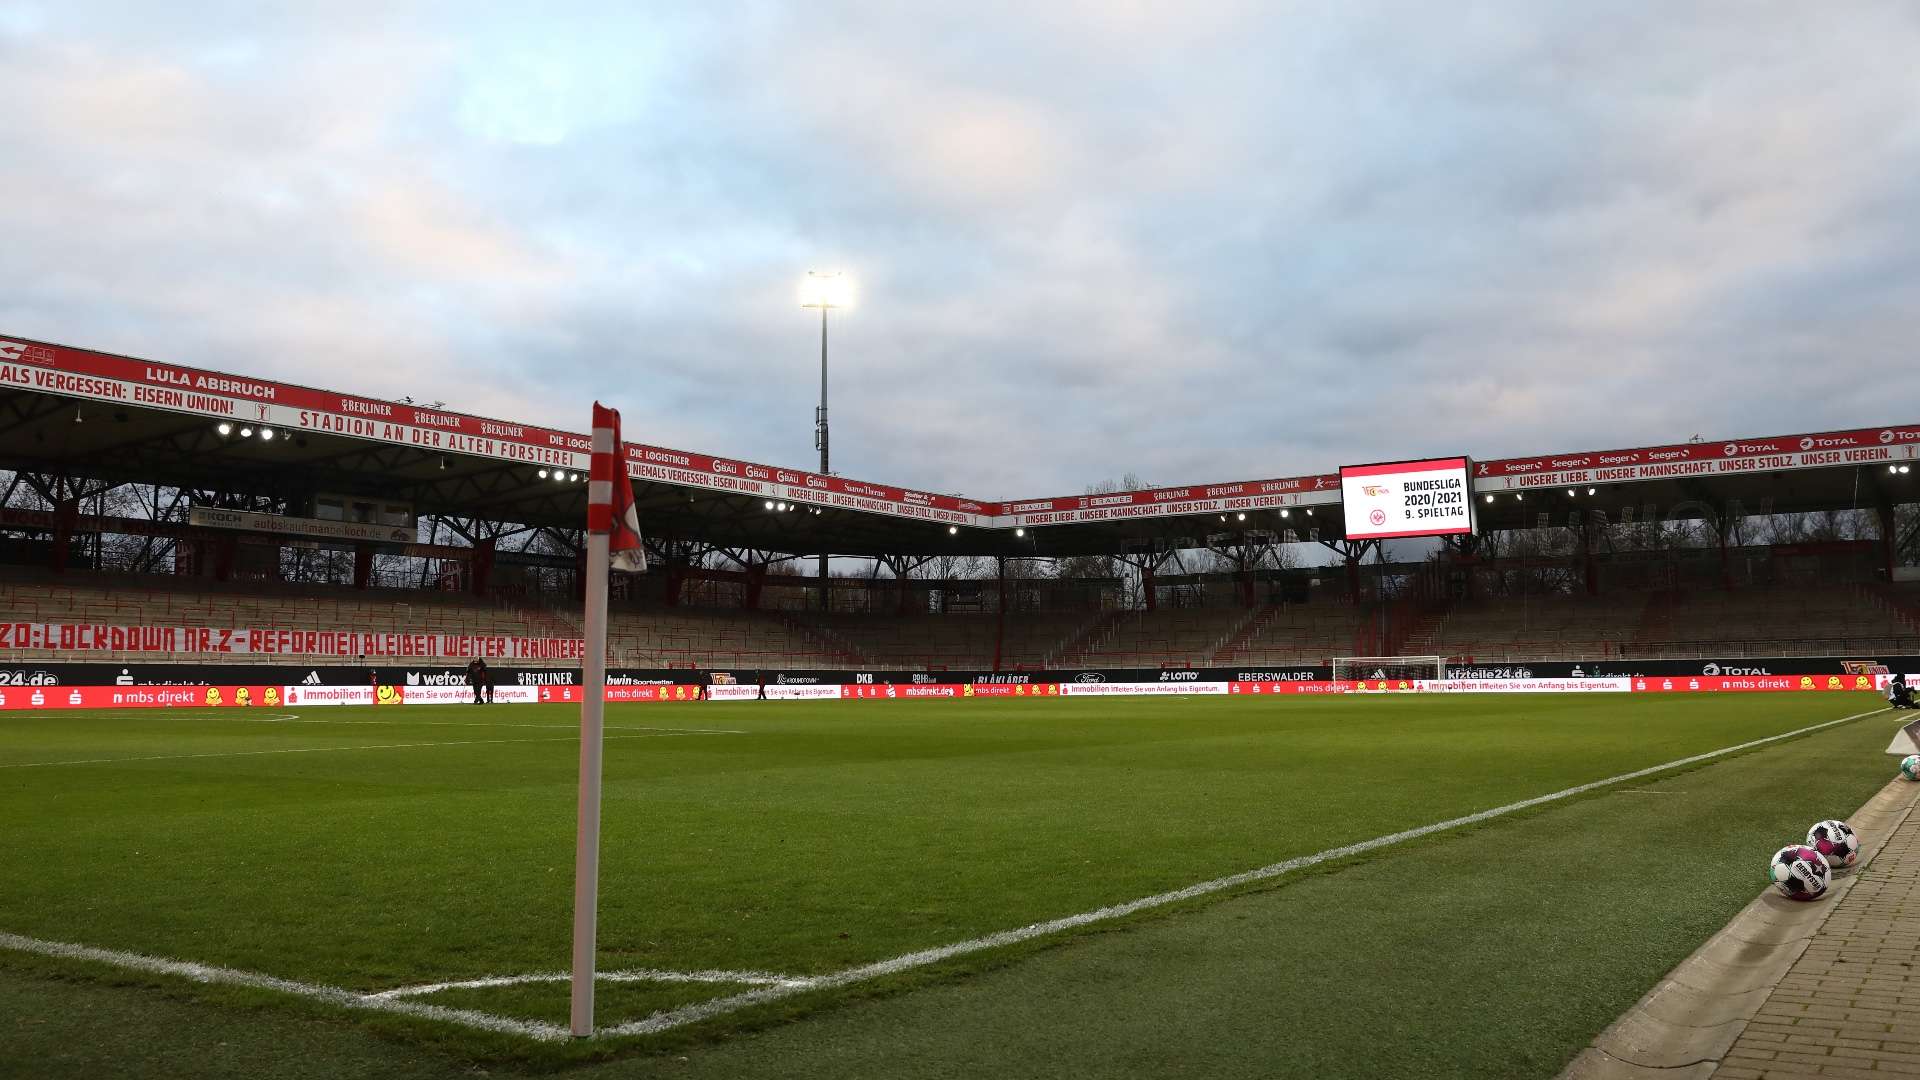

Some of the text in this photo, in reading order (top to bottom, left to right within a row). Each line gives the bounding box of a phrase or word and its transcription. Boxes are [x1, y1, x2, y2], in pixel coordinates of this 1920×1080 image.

[146, 367, 275, 399] LULA ABBRUCH
[0, 365, 234, 415] ALS VERGESSEN: EISERN UNION!
[348, 400, 392, 416] BERLINER
[420, 412, 460, 428] BERLINER
[300, 411, 375, 437] STADION
[383, 424, 404, 441] AN
[412, 429, 440, 447] DER
[448, 434, 493, 455] ALTEN
[486, 422, 524, 438] BERLINER
[550, 434, 564, 446] DIE
[630, 448, 690, 466] DIE LOGISTIKER
[1600, 456, 1629, 464] Seeger
[1648, 450, 1680, 461] Seeger
[1505, 464, 1534, 472] Seeger
[1520, 448, 1892, 486] UNSERE LIEBE. UNSERE MANNSCHAFT. UNSER STOLZ. UNSER VEREIN.
[1552, 460, 1580, 468] Seeger
[632, 464, 762, 494] NIEMALS VERGESSEN: EISERN UNION!
[1404, 478, 1461, 492] BUNDESLIGA
[1211, 485, 1244, 497] BERLINER
[1266, 480, 1299, 492] BERLINER
[1158, 490, 1190, 500] BERLINER
[1404, 492, 1462, 507] 2020/2021
[788, 487, 812, 500] UNSERE
[832, 494, 855, 507] UNSERE
[897, 504, 914, 516] UNSER
[1026, 496, 1286, 524] UNSERE LIEBE. UNSERE MANNSCHAFT. UNSER STOLZ. UNSER VEREIN.
[1405, 506, 1464, 519] 9. SPIELTAG
[364, 632, 437, 656] BLEIBEN
[444, 635, 506, 657] WEITER
[423, 671, 467, 686] wefox
[526, 672, 572, 685] BERLINER
[856, 674, 872, 684] DKB
[1238, 672, 1314, 682] EBERSWALDER
[1447, 668, 1532, 679] kfzteile24.de
[606, 674, 632, 686] bwin
[1428, 682, 1476, 690] Immobilien
[1538, 682, 1564, 690] Anfang
[1580, 682, 1620, 690] Eigentum.
[1732, 680, 1755, 688] mbs
[1758, 678, 1790, 688] direkt
[304, 688, 360, 700] Immobilien
[614, 689, 630, 698] mbs
[632, 689, 653, 698] direkt
[716, 687, 749, 696] Immobilien
[1156, 684, 1178, 693] Anfang
[126, 690, 154, 702] mbs
[157, 690, 194, 702] direkt
[426, 690, 438, 698] Sie
[494, 690, 528, 700] Eigentum.
